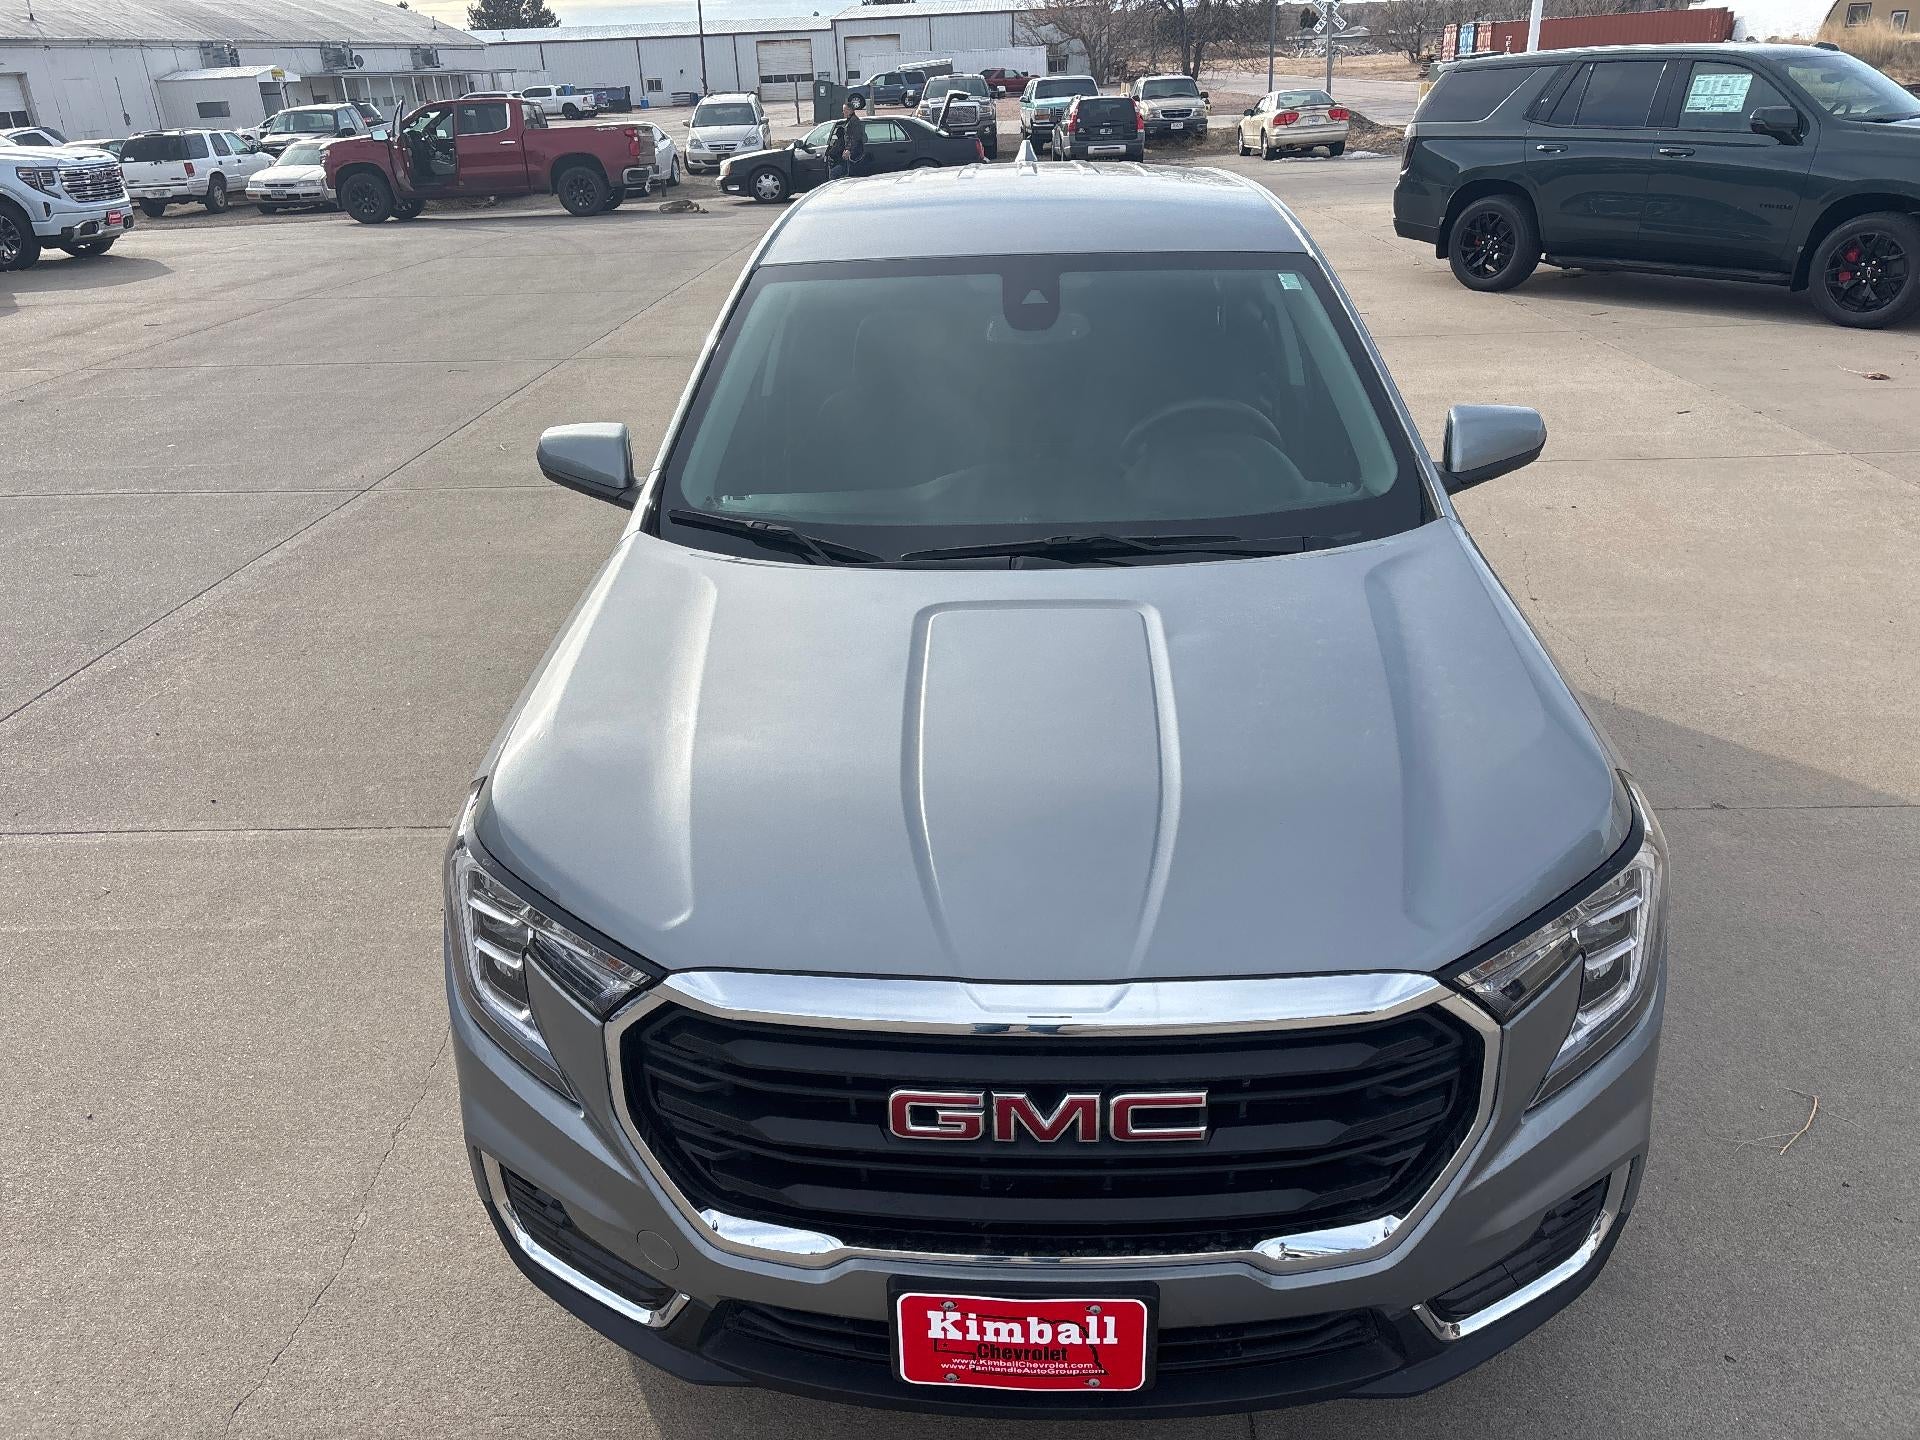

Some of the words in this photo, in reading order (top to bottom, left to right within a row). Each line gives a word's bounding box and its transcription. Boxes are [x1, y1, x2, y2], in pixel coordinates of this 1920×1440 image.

[888, 1089, 1208, 1143] GMC
[926, 1309, 1119, 1346] Kimball
[976, 1343, 1068, 1362] Chevrolet
[940, 1362, 1105, 1376] www.PanhandleAutoGroup.com
[951, 1358, 1093, 1370] www.KimballChevrolet.com
